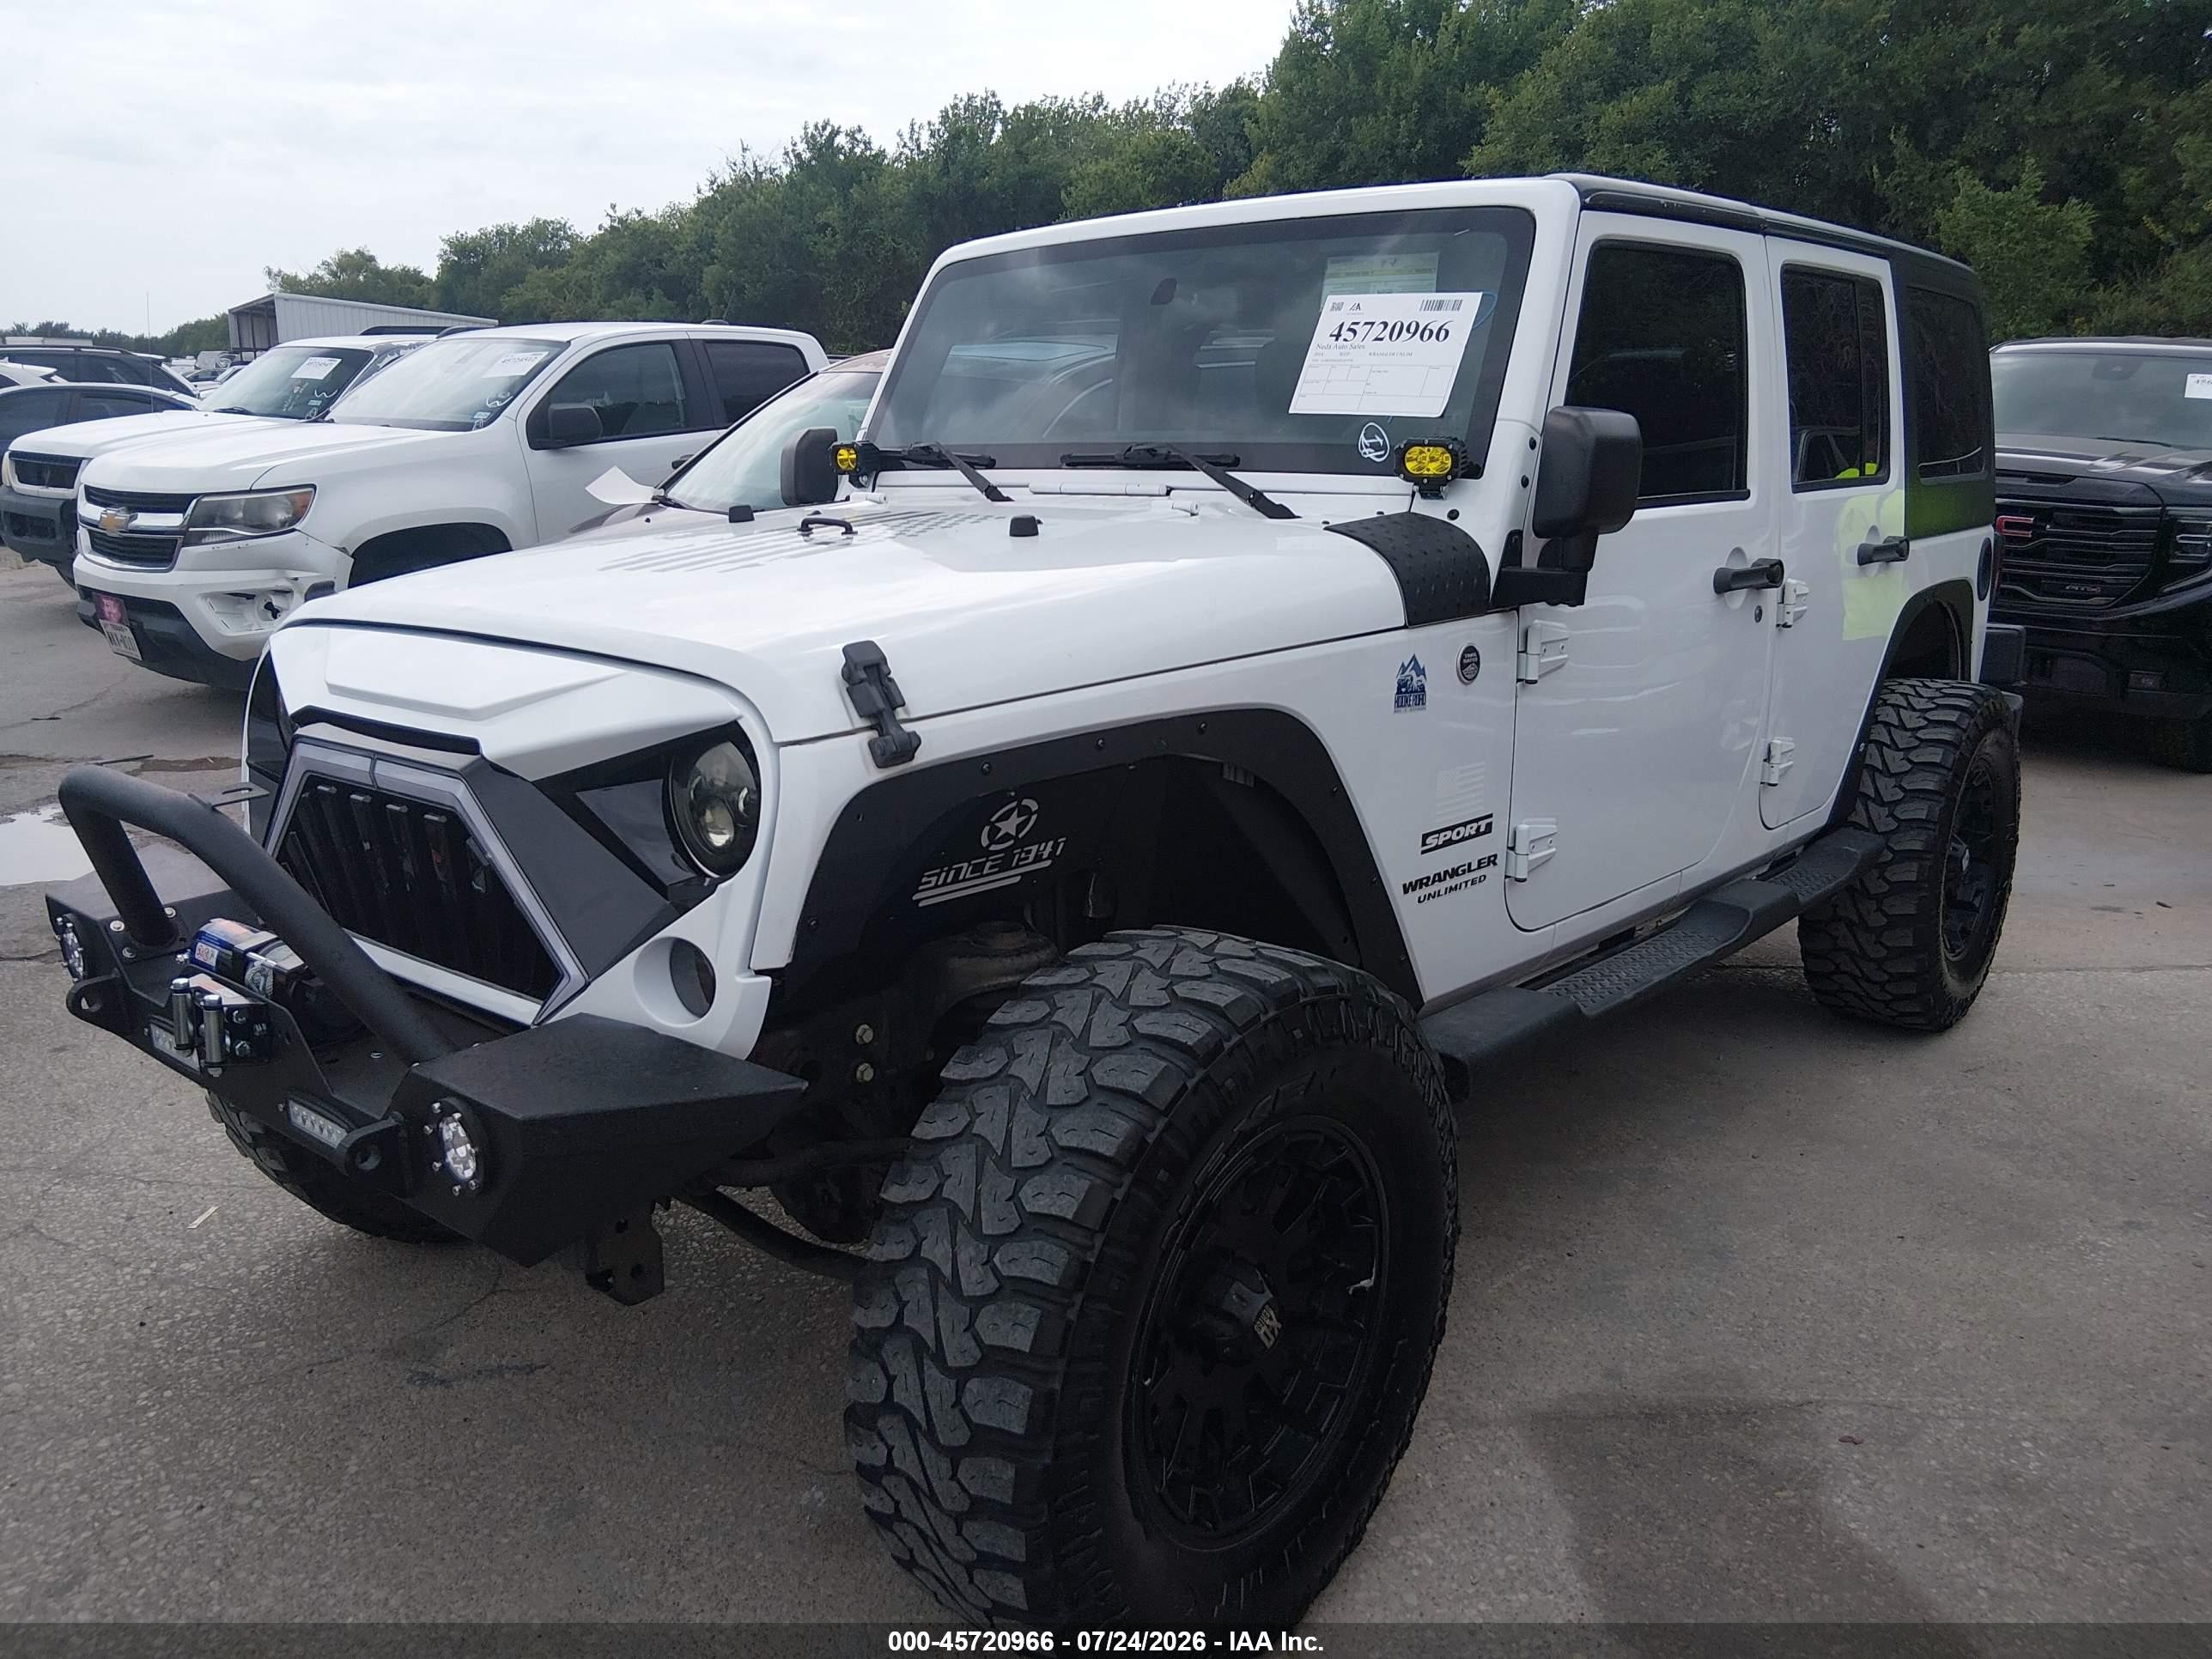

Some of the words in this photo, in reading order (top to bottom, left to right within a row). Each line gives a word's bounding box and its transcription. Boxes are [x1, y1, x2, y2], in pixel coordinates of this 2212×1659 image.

[1329, 320, 1454, 342] 45720966
[1422, 817, 1492, 848] SPORT
[1012, 837, 1066, 867] 1941
[1401, 854, 1498, 895] WRANGLER
[1417, 874, 1486, 904] UNLIMITED
